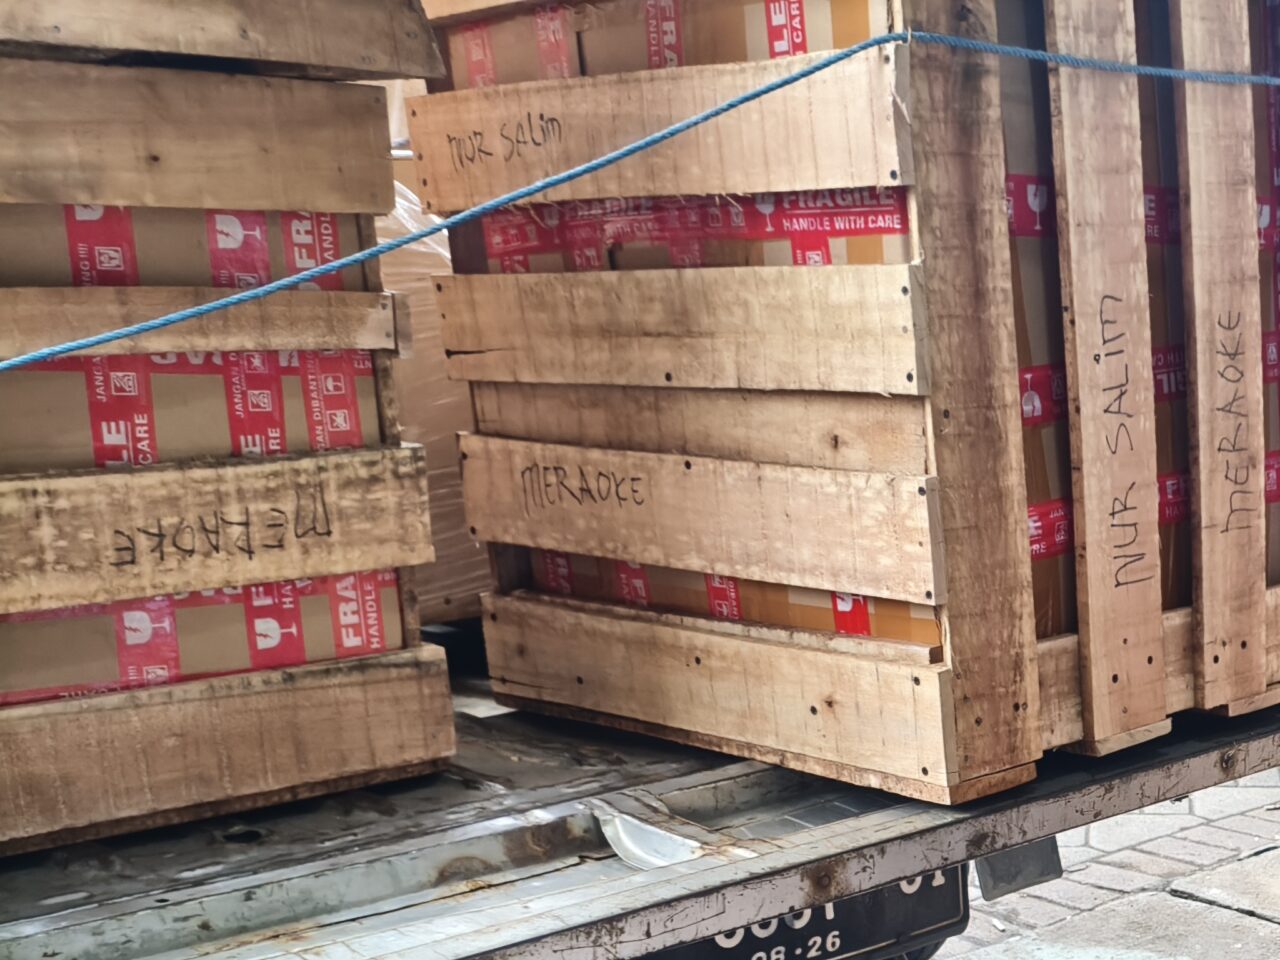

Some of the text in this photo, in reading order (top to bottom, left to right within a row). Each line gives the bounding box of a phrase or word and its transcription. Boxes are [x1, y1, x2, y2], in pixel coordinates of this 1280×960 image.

[782, 213, 901, 231] HANDLE WITH CARE
[1109, 480, 1154, 589] NUR
